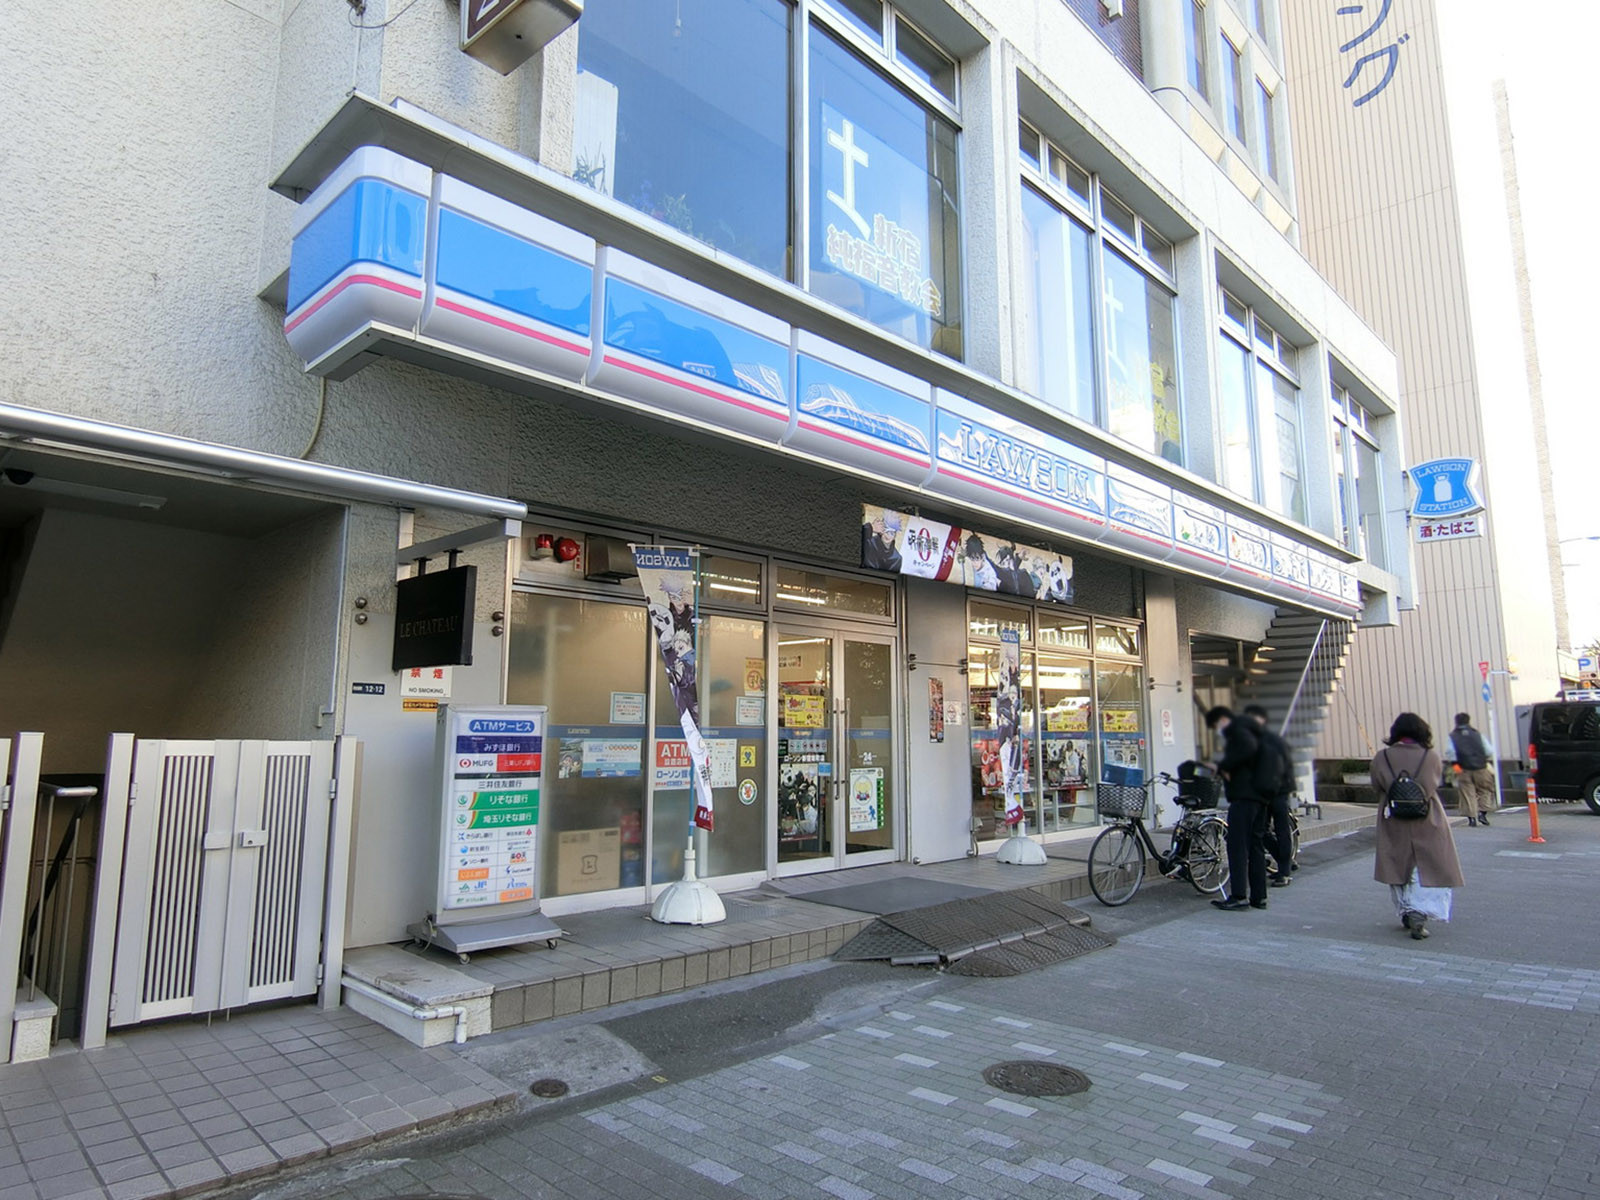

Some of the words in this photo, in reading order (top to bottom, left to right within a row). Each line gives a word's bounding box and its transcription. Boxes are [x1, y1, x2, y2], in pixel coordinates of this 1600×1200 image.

[960, 422, 1090, 506] LAWSON
[1416, 463, 1467, 478] LAWSON
[1419, 497, 1469, 512] STATION
[1577, 658, 1591, 671] P
[472, 721, 532, 732] ATMサービス
[483, 743, 521, 752] みずほ銀行
[660, 743, 692, 758] ATM
[472, 759, 494, 767] MUFG
[478, 780, 523, 790] 三井住友銀行
[489, 794, 530, 805] りそな銀行
[482, 812, 532, 824] 埼玉りそな銀行
